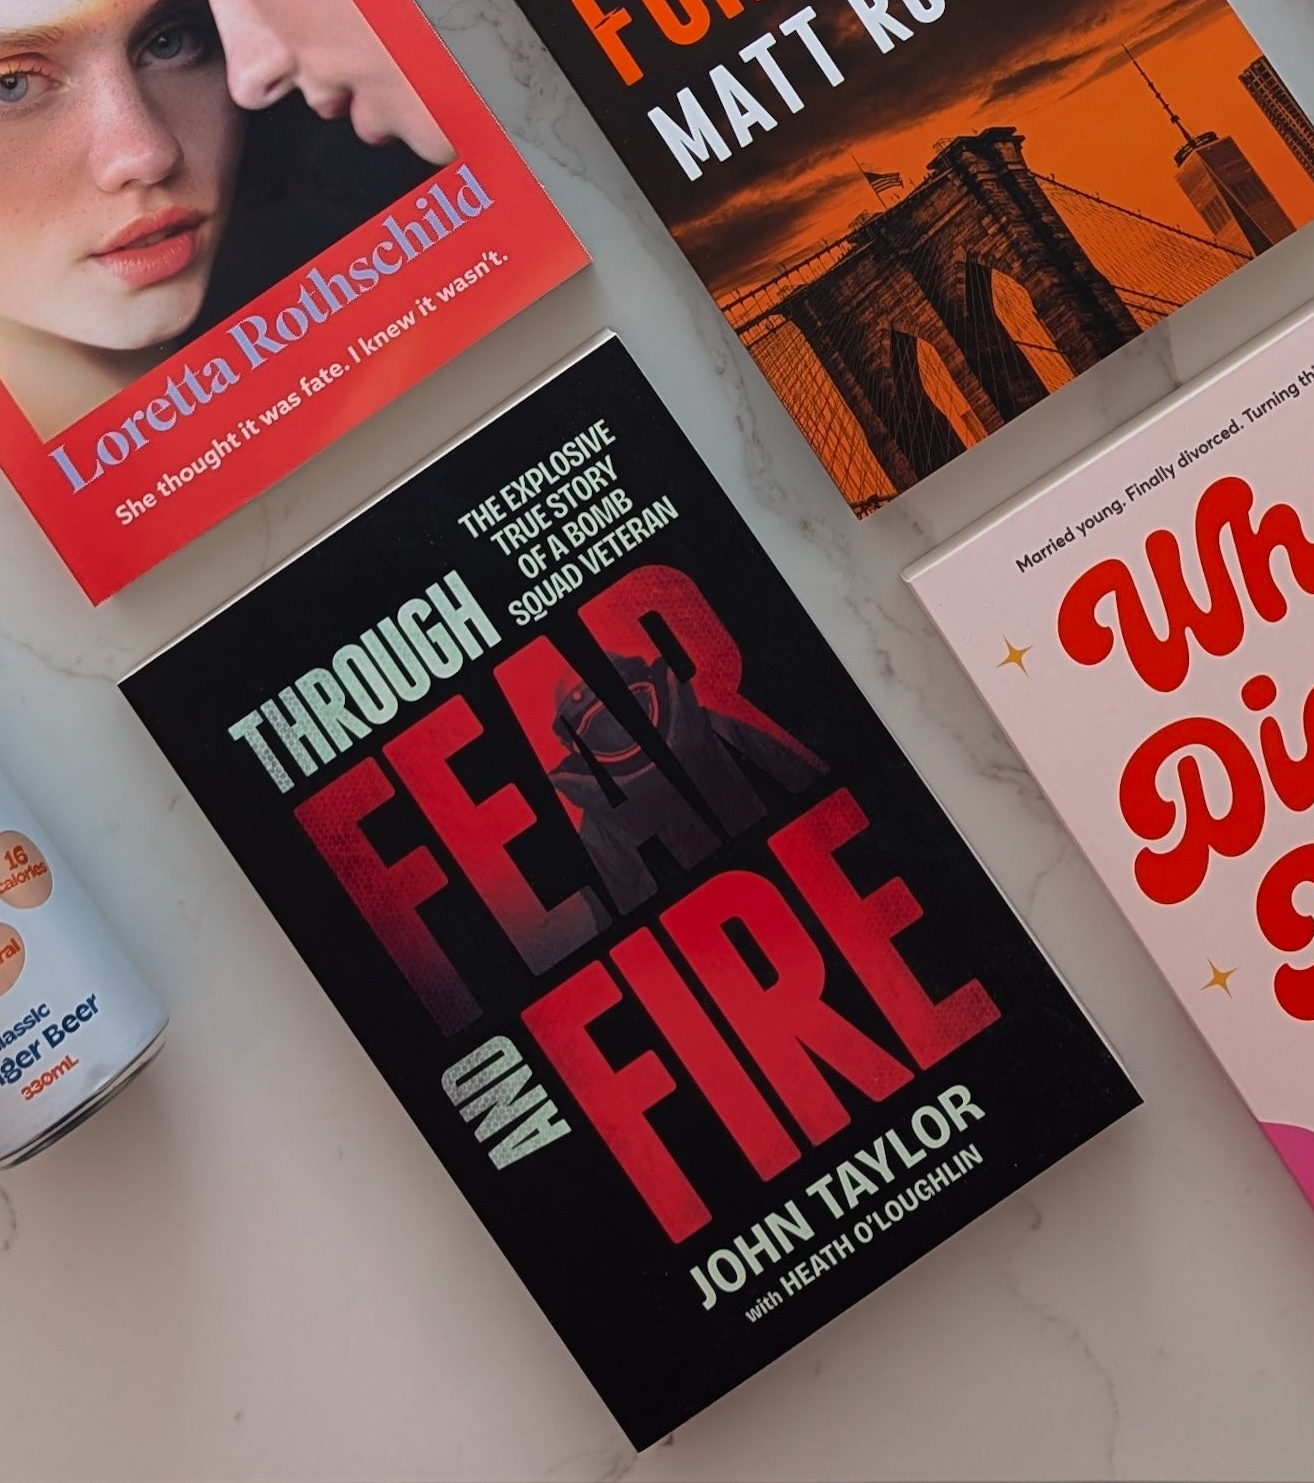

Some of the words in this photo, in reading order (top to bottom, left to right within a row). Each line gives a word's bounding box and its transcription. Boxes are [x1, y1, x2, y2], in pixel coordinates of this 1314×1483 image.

[646, 4, 845, 182] MATT
[47, 356, 241, 494] Loretta
[225, 163, 495, 370] Rothschild
[457, 494, 508, 539] THE
[498, 418, 617, 512] EXPLOSIVE
[489, 502, 553, 556] TRUE
[545, 453, 618, 519] STORY
[517, 543, 548, 579] OF
[546, 533, 570, 562] A
[561, 487, 634, 548] BOMB
[1014, 525, 1076, 573] Married
[1075, 498, 1127, 538] young.
[1124, 463, 1176, 502] Finally
[1177, 417, 1245, 469] divorced.
[1241, 382, 1301, 423] Turning
[507, 562, 584, 626] SQUAD
[577, 494, 680, 575] VETERAN
[227, 569, 503, 794] THROUGH
[3, 843, 29, 871] 16
[290, 556, 830, 1041] FEAR
[20, 1054, 80, 1101] 330mL
[41, 992, 99, 1049] Beer
[520, 787, 1002, 1244] FIRE
[440, 1034, 573, 1171] AND
[689, 1199, 816, 1311] JOHN
[804, 1083, 986, 1220] TAYLOR
[744, 1290, 784, 1323] with
[778, 1232, 856, 1297] HEATH
[853, 1142, 984, 1244] O'LOUGHLIN
